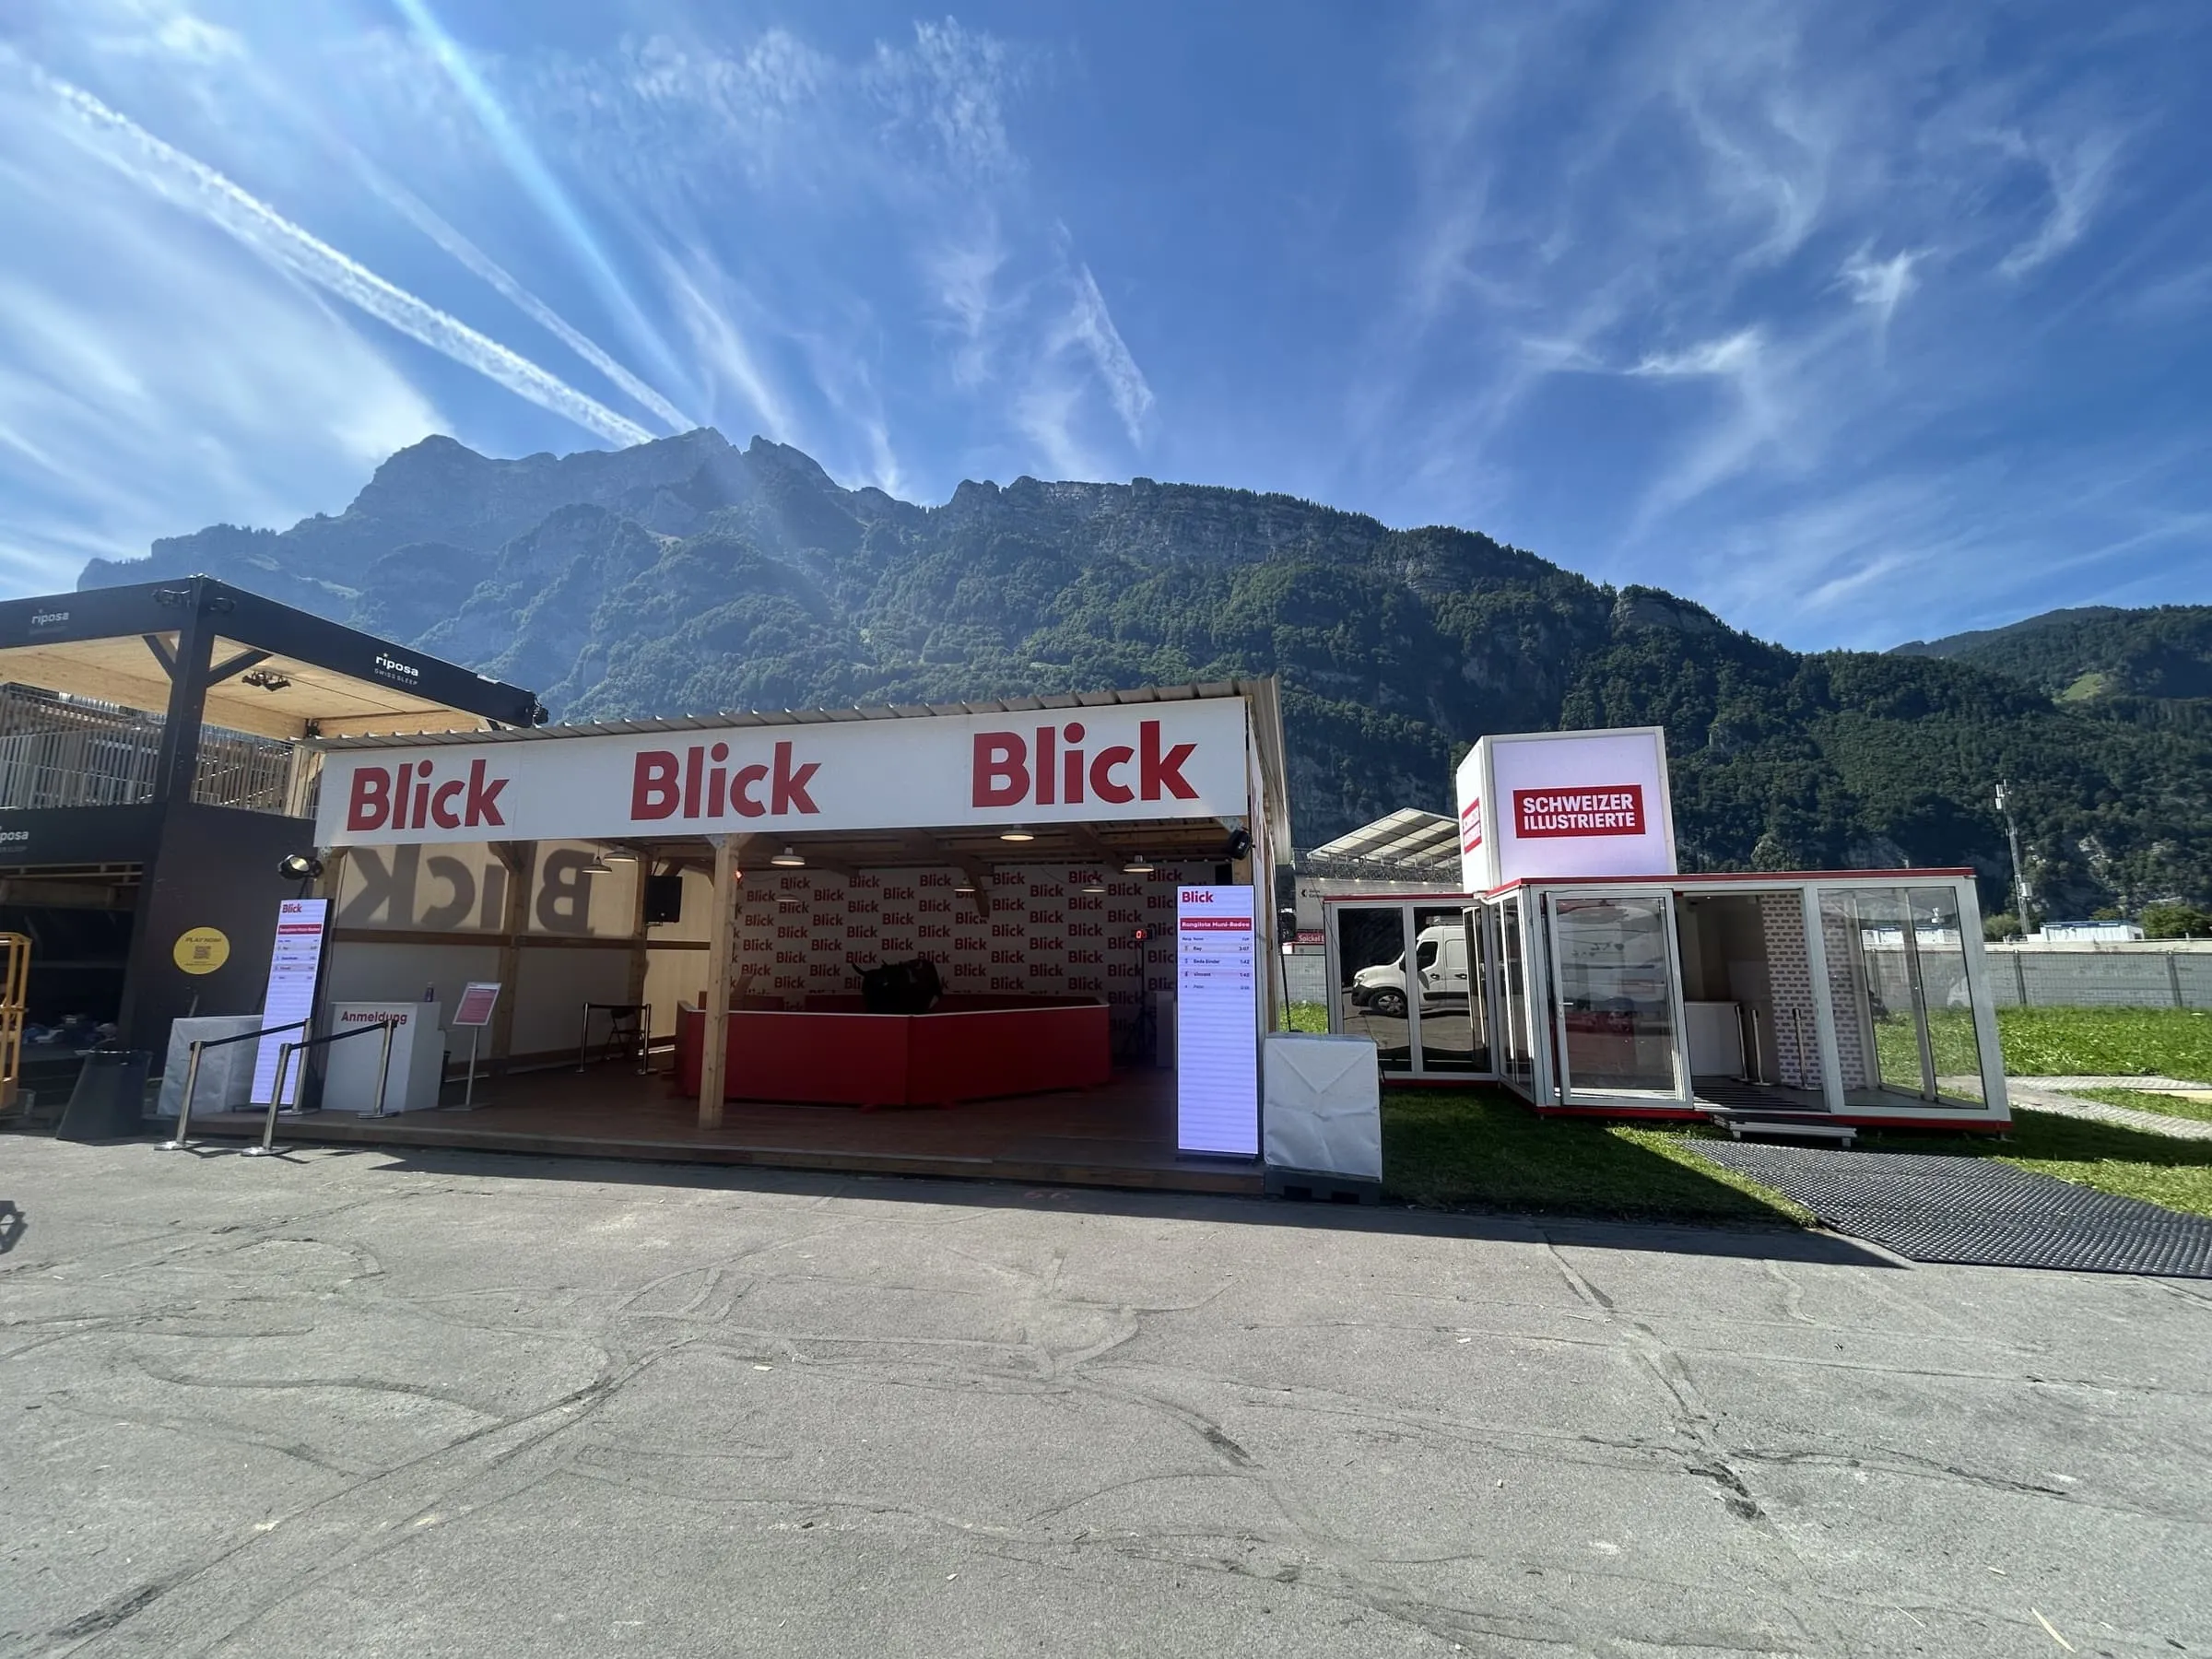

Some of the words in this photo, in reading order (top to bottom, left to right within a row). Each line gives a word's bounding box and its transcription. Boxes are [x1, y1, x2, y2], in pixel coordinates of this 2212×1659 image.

[31, 608, 70, 626] riposa
[375, 653, 419, 677] riposa
[972, 720, 1200, 806] Blick
[631, 742, 821, 820] Blick
[347, 759, 510, 831] Blick
[1523, 793, 1635, 814] SCHWEIZER
[1524, 812, 1636, 830] ILLUSTRIERTE
[0, 826, 29, 843] posa
[920, 874, 951, 887] Blick
[993, 871, 1025, 885] Blick
[1068, 870, 1103, 884] Blick
[1147, 868, 1182, 882] Blick
[781, 877, 811, 890] Blick
[849, 876, 880, 888] Blick
[747, 889, 776, 902] Blick
[814, 888, 844, 901] Blick
[883, 887, 914, 900] Blick
[1030, 884, 1064, 898] Blick
[1108, 883, 1143, 896] Blick
[1147, 895, 1175, 909] Blic
[1182, 890, 1214, 903] Blick
[282, 903, 302, 913] Blick
[779, 901, 809, 913] Blick
[848, 900, 879, 912] Blick
[919, 899, 951, 912] Blick
[992, 898, 1025, 911] Blick
[1068, 897, 1103, 911] Blick
[745, 914, 774, 926] Blick
[813, 913, 843, 926] Blick
[882, 912, 914, 925] Blick
[1030, 910, 1064, 924] Blick
[1108, 910, 1143, 923] Blick
[777, 926, 808, 938] Blick
[847, 925, 878, 938] Blick
[918, 925, 950, 937] Blick
[992, 924, 1025, 936] Blick
[1068, 924, 1103, 936] Blick
[743, 939, 773, 951] Blick
[811, 938, 842, 951] Blick
[881, 938, 913, 950] Blick
[954, 937, 987, 950] Blick
[1030, 936, 1064, 950] Blick
[776, 951, 806, 963] Blick
[845, 951, 877, 963] Blick
[991, 950, 1025, 963] Blick
[1068, 949, 1103, 964] Blick
[1147, 949, 1175, 963] Blic
[741, 964, 771, 976] Blick
[810, 964, 841, 977] Blick
[954, 963, 986, 977] Blick
[1030, 963, 1064, 977] Blick
[774, 976, 806, 989] Blick
[844, 976, 861, 989] Bli
[990, 976, 1025, 990] Blick
[1068, 976, 1103, 990] Blick
[1147, 977, 1175, 991] Blic
[340, 1010, 407, 1025] Anmeldung
